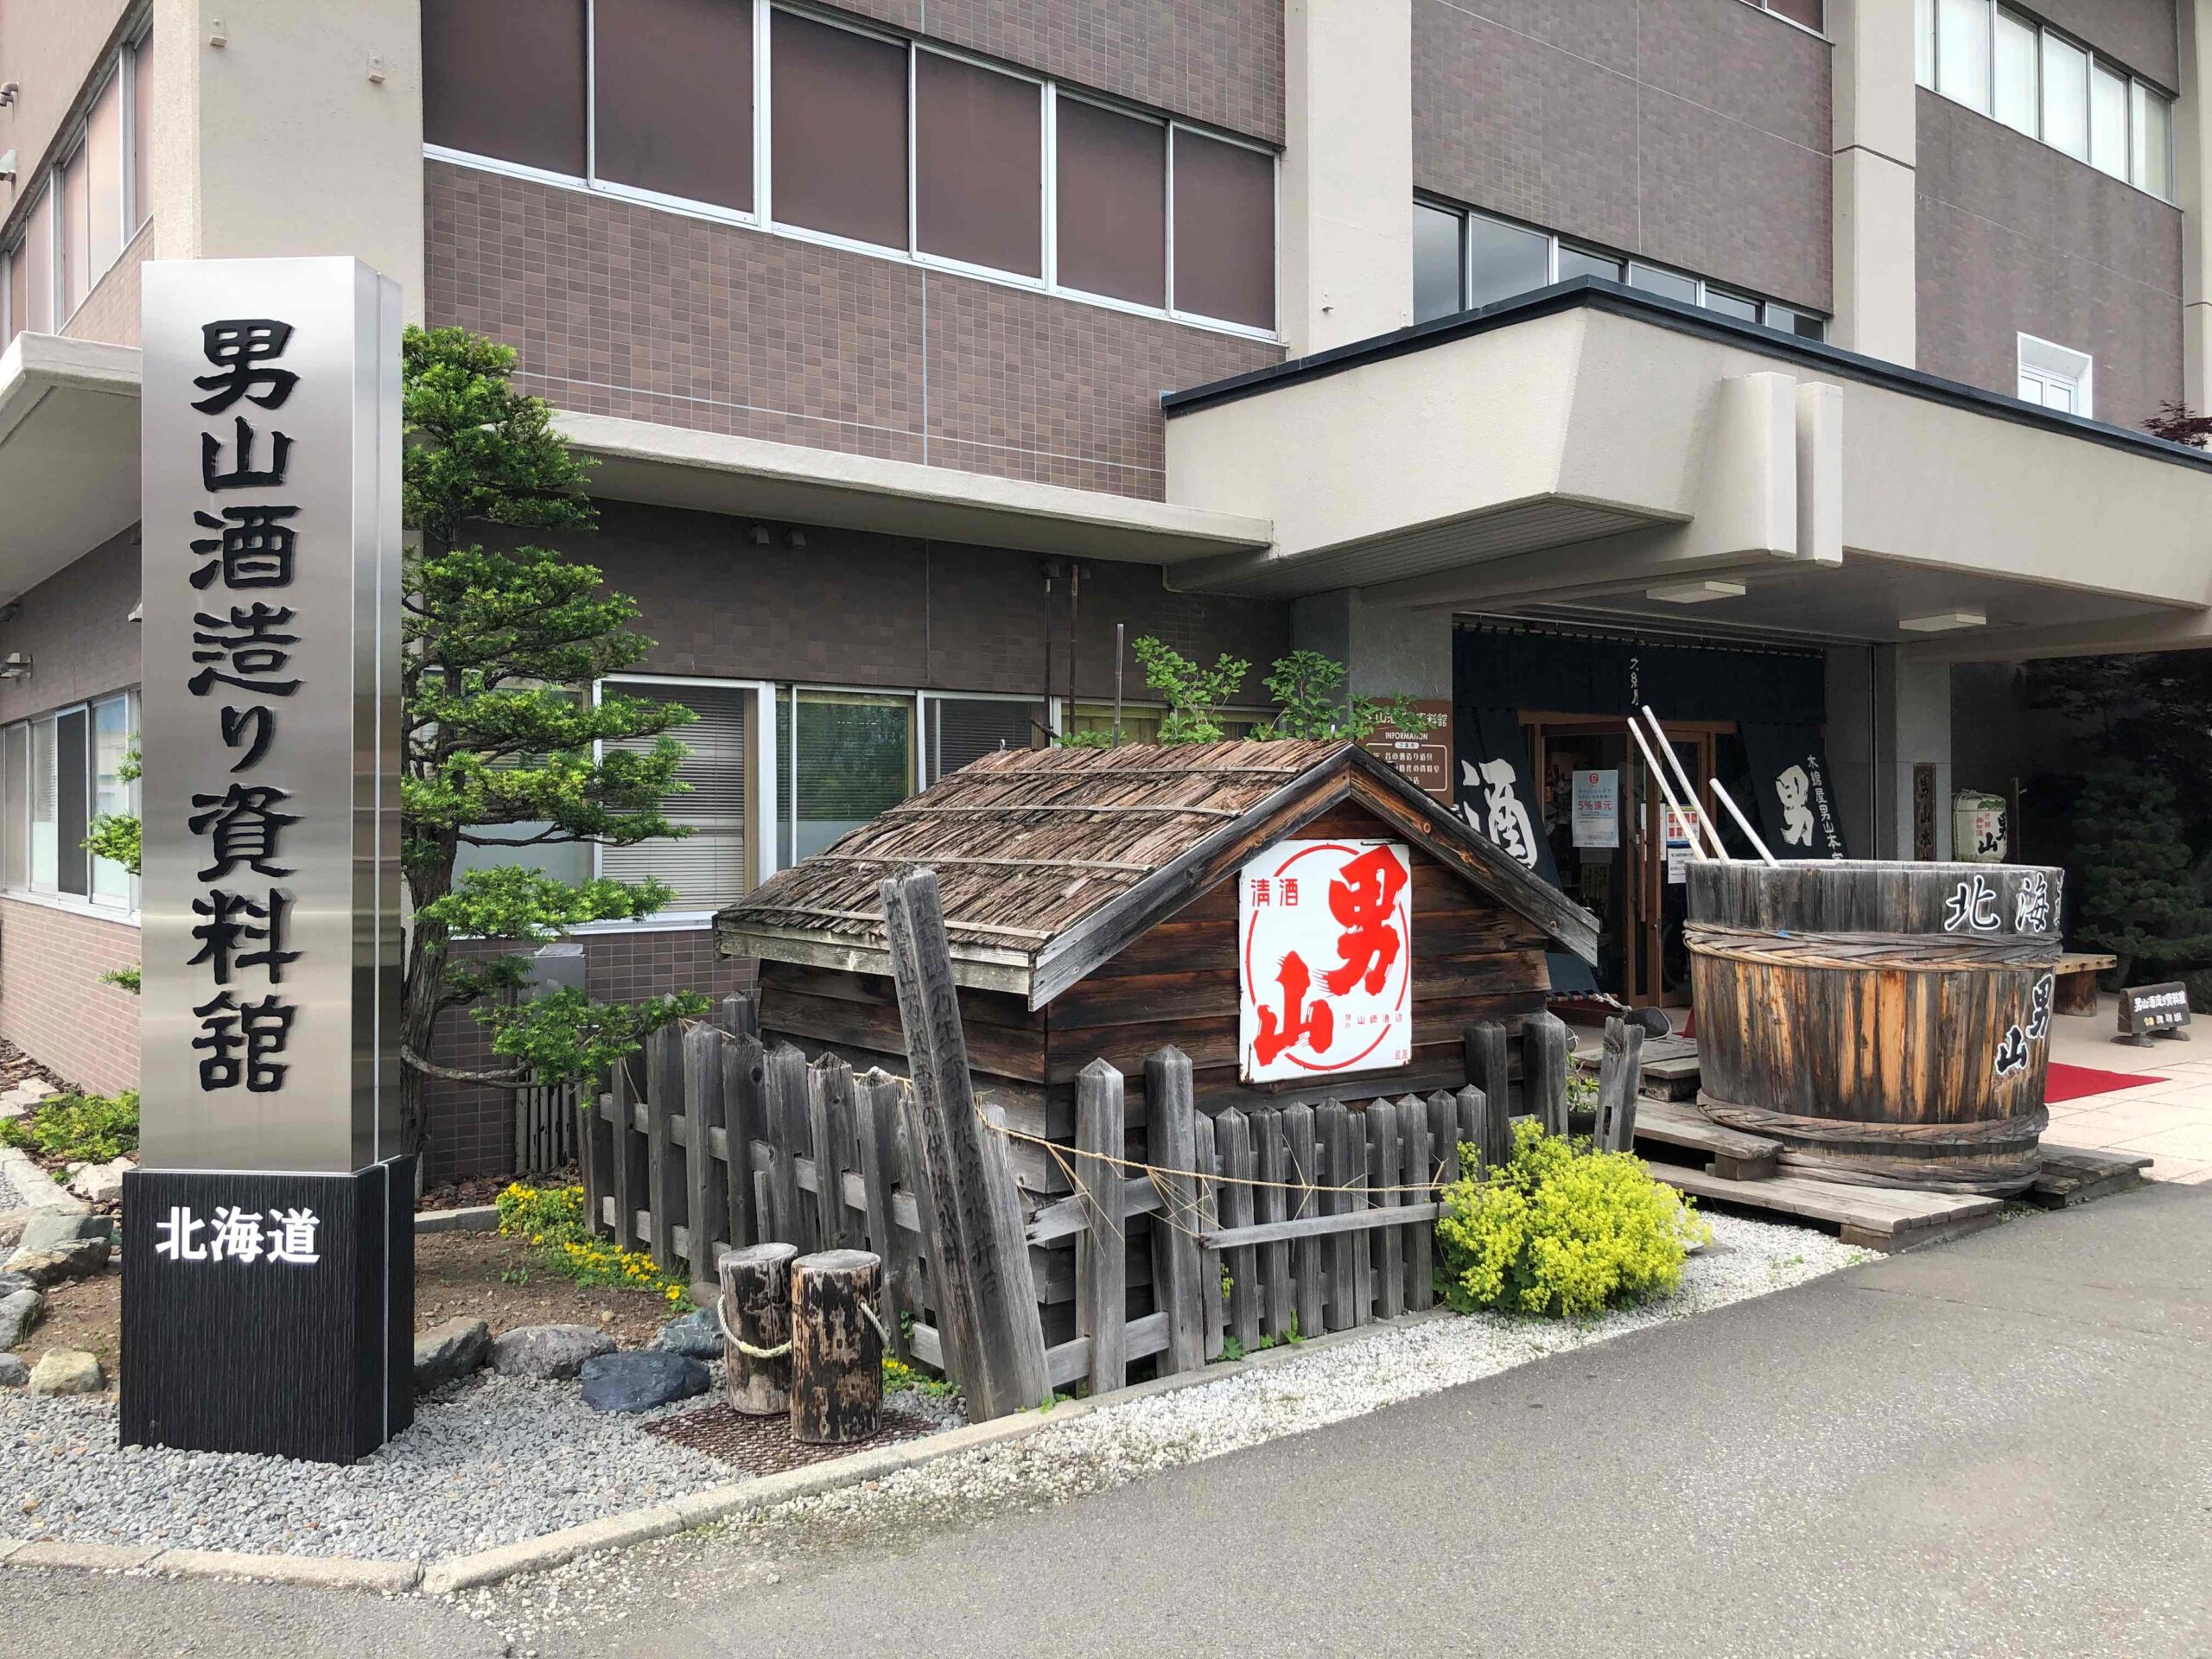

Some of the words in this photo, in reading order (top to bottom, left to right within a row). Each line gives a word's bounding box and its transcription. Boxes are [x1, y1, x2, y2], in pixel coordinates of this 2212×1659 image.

[187, 318, 302, 1092] 男山酒造り資料館
[1775, 765, 1815, 847] 男
[1250, 877, 1300, 908] 清酒
[155, 1206, 321, 1264] 北海道
